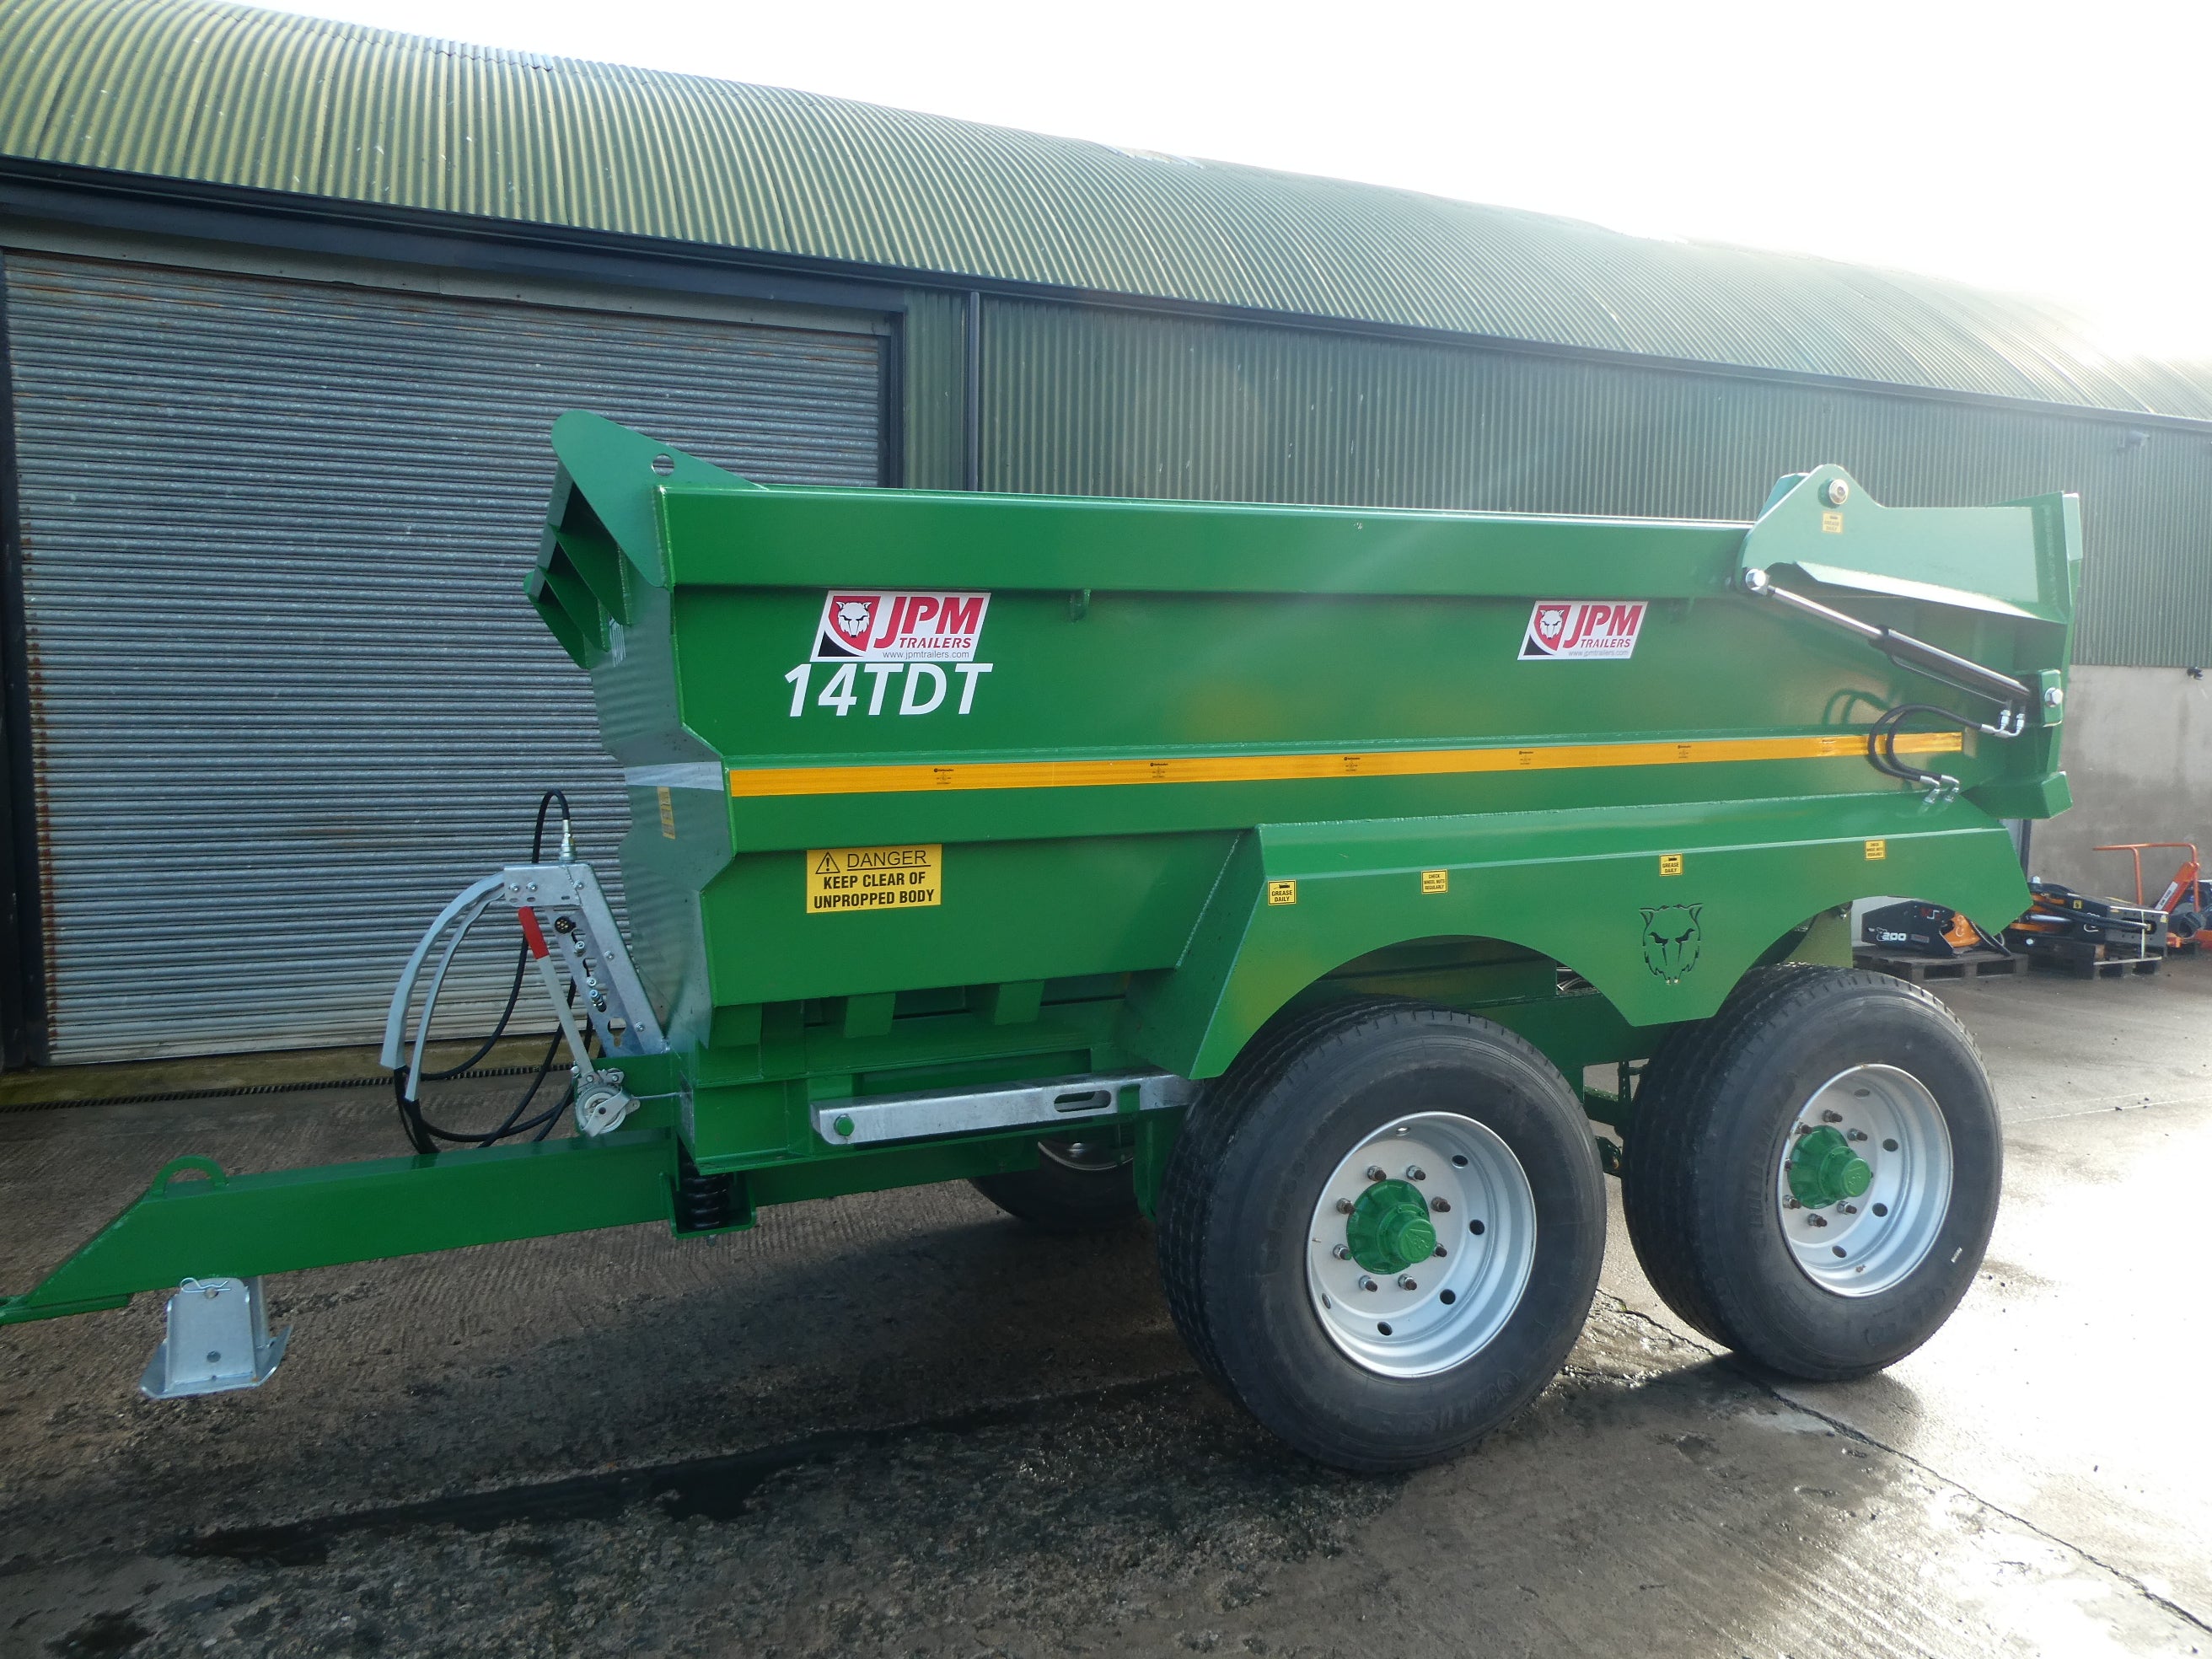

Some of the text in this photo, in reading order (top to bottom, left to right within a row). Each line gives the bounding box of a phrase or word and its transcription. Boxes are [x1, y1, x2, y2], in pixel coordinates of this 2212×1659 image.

[874, 596, 985, 649] JPM
[1562, 604, 1643, 649] JPM
[899, 637, 972, 649] TRAILERS
[1581, 639, 1631, 648] TRAILERS
[883, 649, 970, 659] www.jpmtrailers.com
[784, 663, 994, 717] 14TDT
[847, 850, 927, 868] DANGER
[824, 872, 926, 889] KEEP CLEAR OF
[813, 889, 935, 909] UNPROPPED BODY
